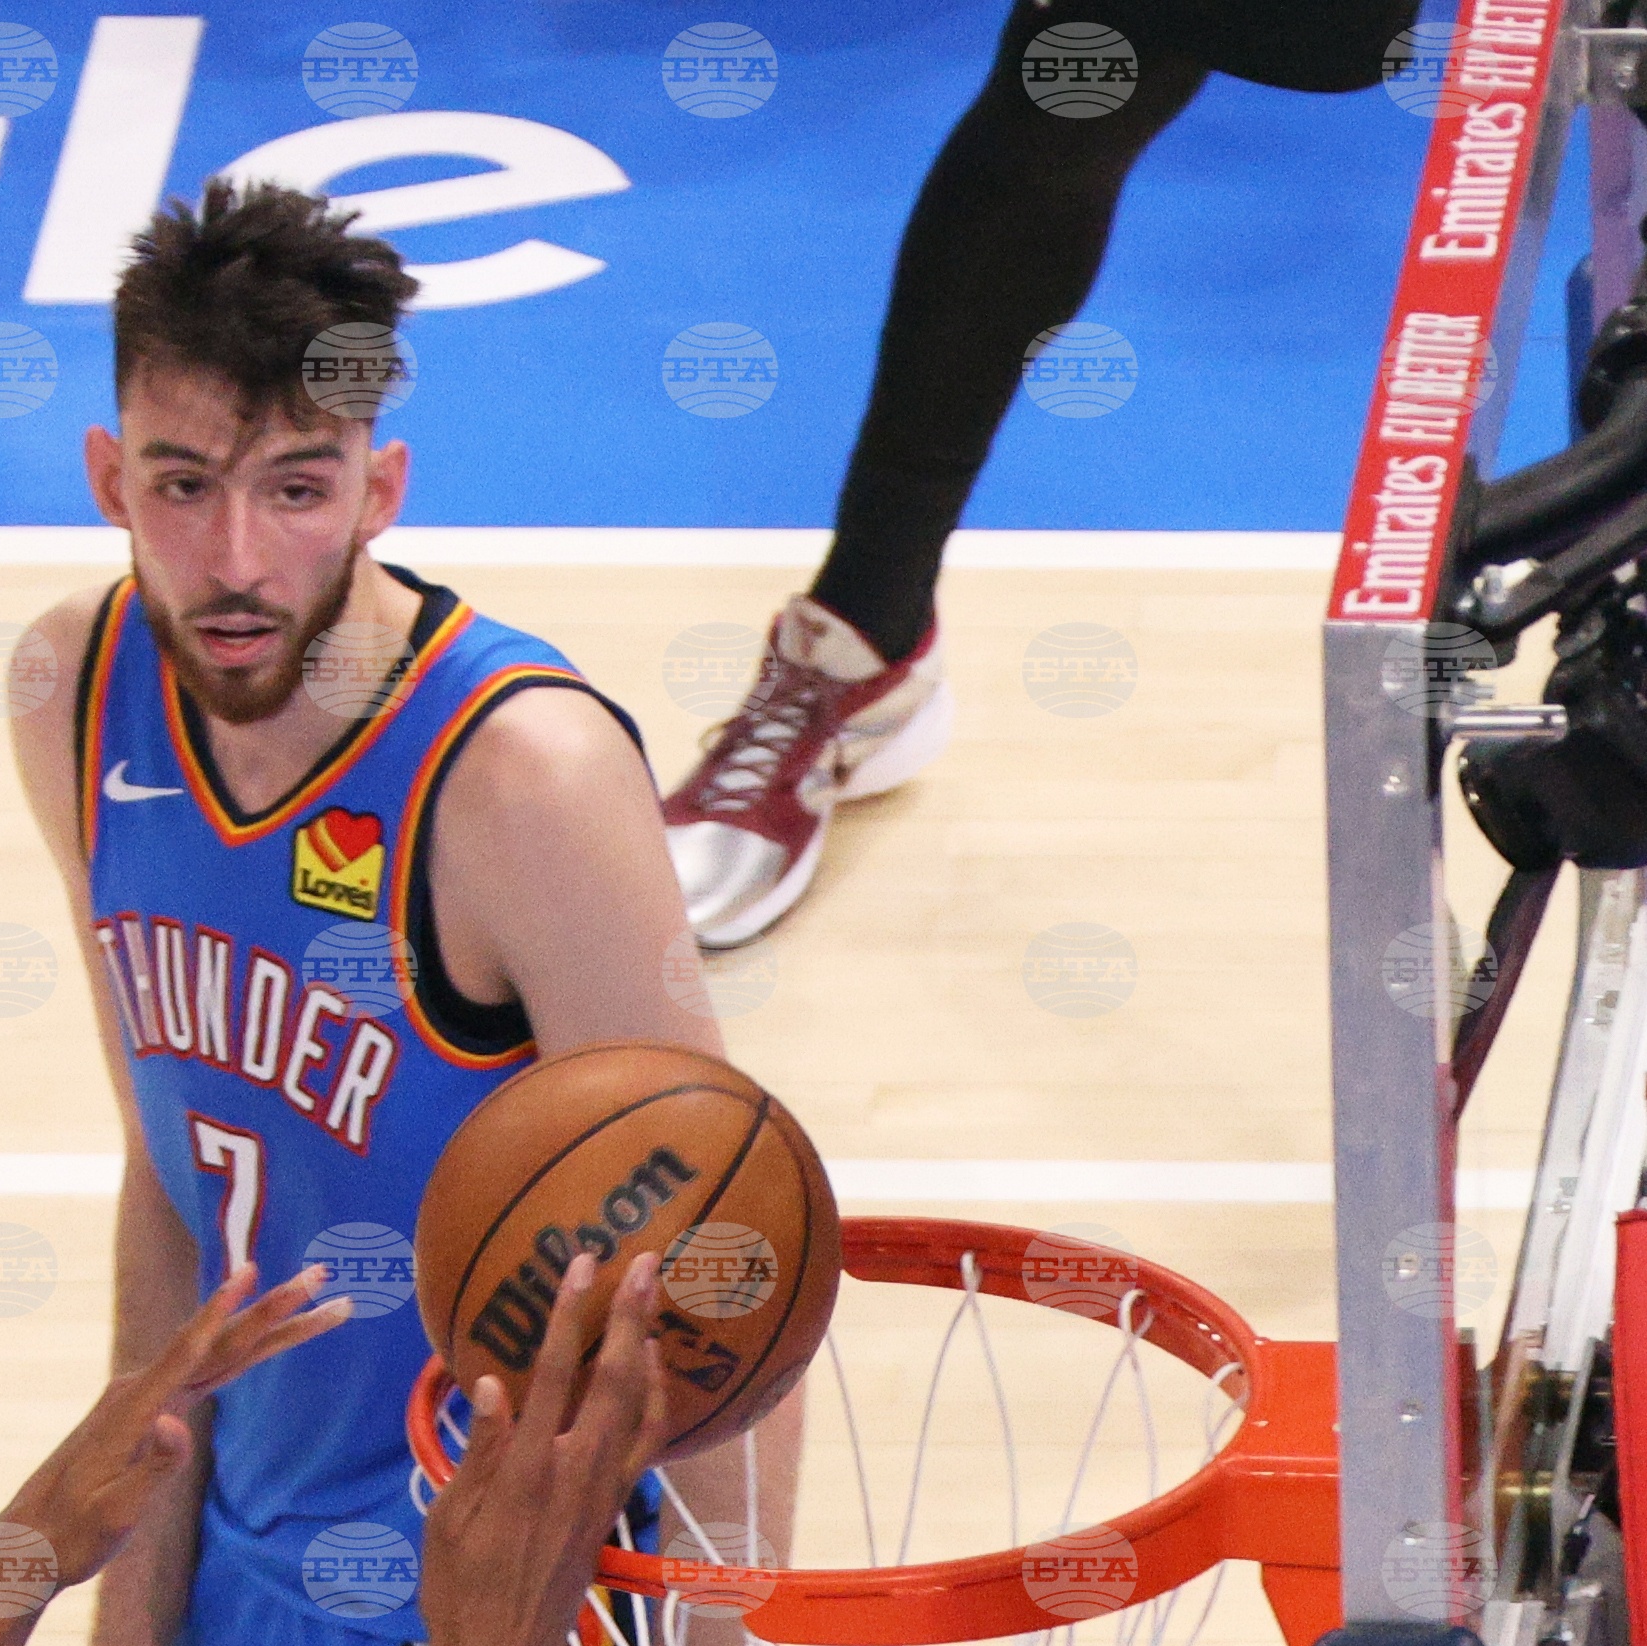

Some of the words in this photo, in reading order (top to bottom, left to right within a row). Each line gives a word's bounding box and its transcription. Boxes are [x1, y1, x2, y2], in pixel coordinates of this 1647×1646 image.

[1458, 48, 1539, 89] FLY
[1419, 101, 1528, 261] Emirates
[1379, 400, 1460, 441] FLY
[1388, 311, 1482, 398] BETTER
[1342, 454, 1449, 615] Emirates
[92, 911, 400, 1158] THUNDER
[187, 1110, 268, 1283] 7
[468, 1144, 700, 1373] Wilson
